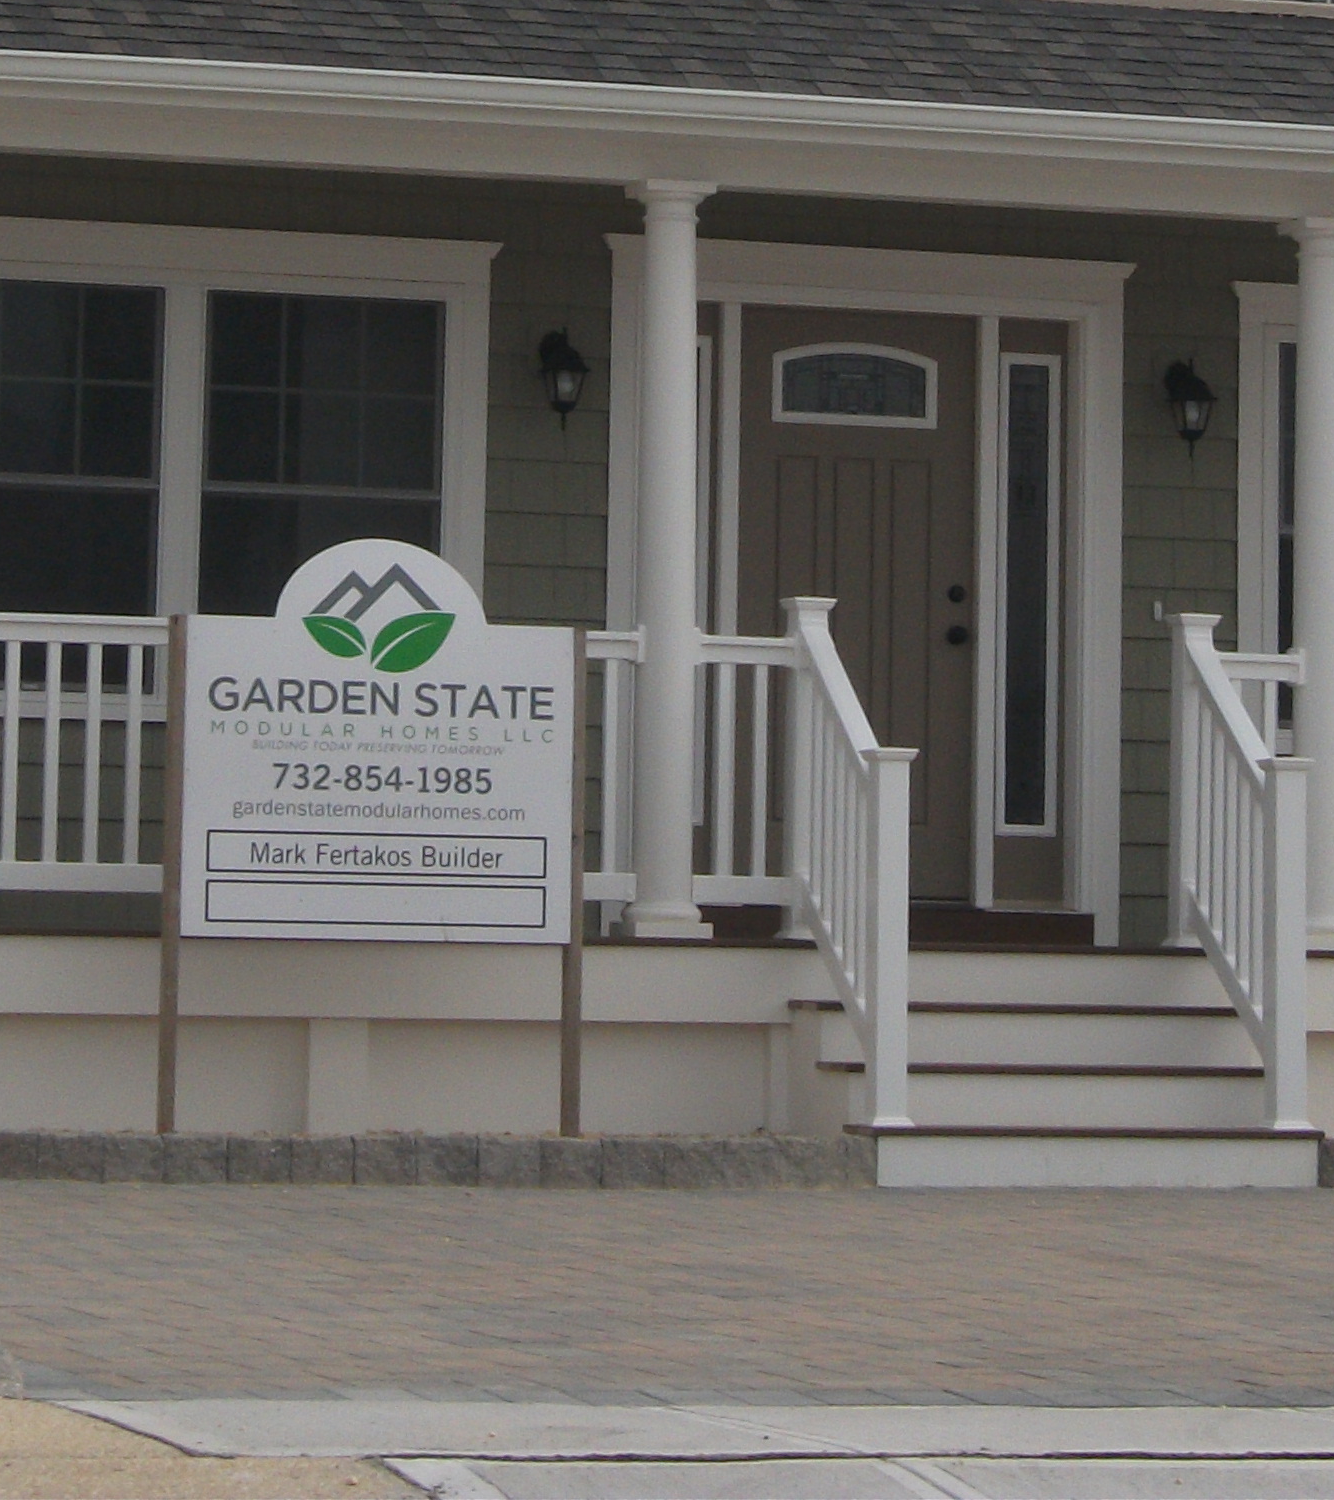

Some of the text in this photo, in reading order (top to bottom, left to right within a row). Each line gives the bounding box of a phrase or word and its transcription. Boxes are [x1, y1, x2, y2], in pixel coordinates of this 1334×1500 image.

[208, 676, 555, 721] GARDEN STATE
[210, 720, 554, 743] MODULAR HOMES LLC
[252, 740, 505, 756] BUILDING TODAY PRESERVING TOMORROW
[272, 762, 493, 795] 732-854-1985
[232, 800, 526, 822] gardenstatemodularhomes.com
[250, 842, 503, 869] Mark Fertakos Builder
